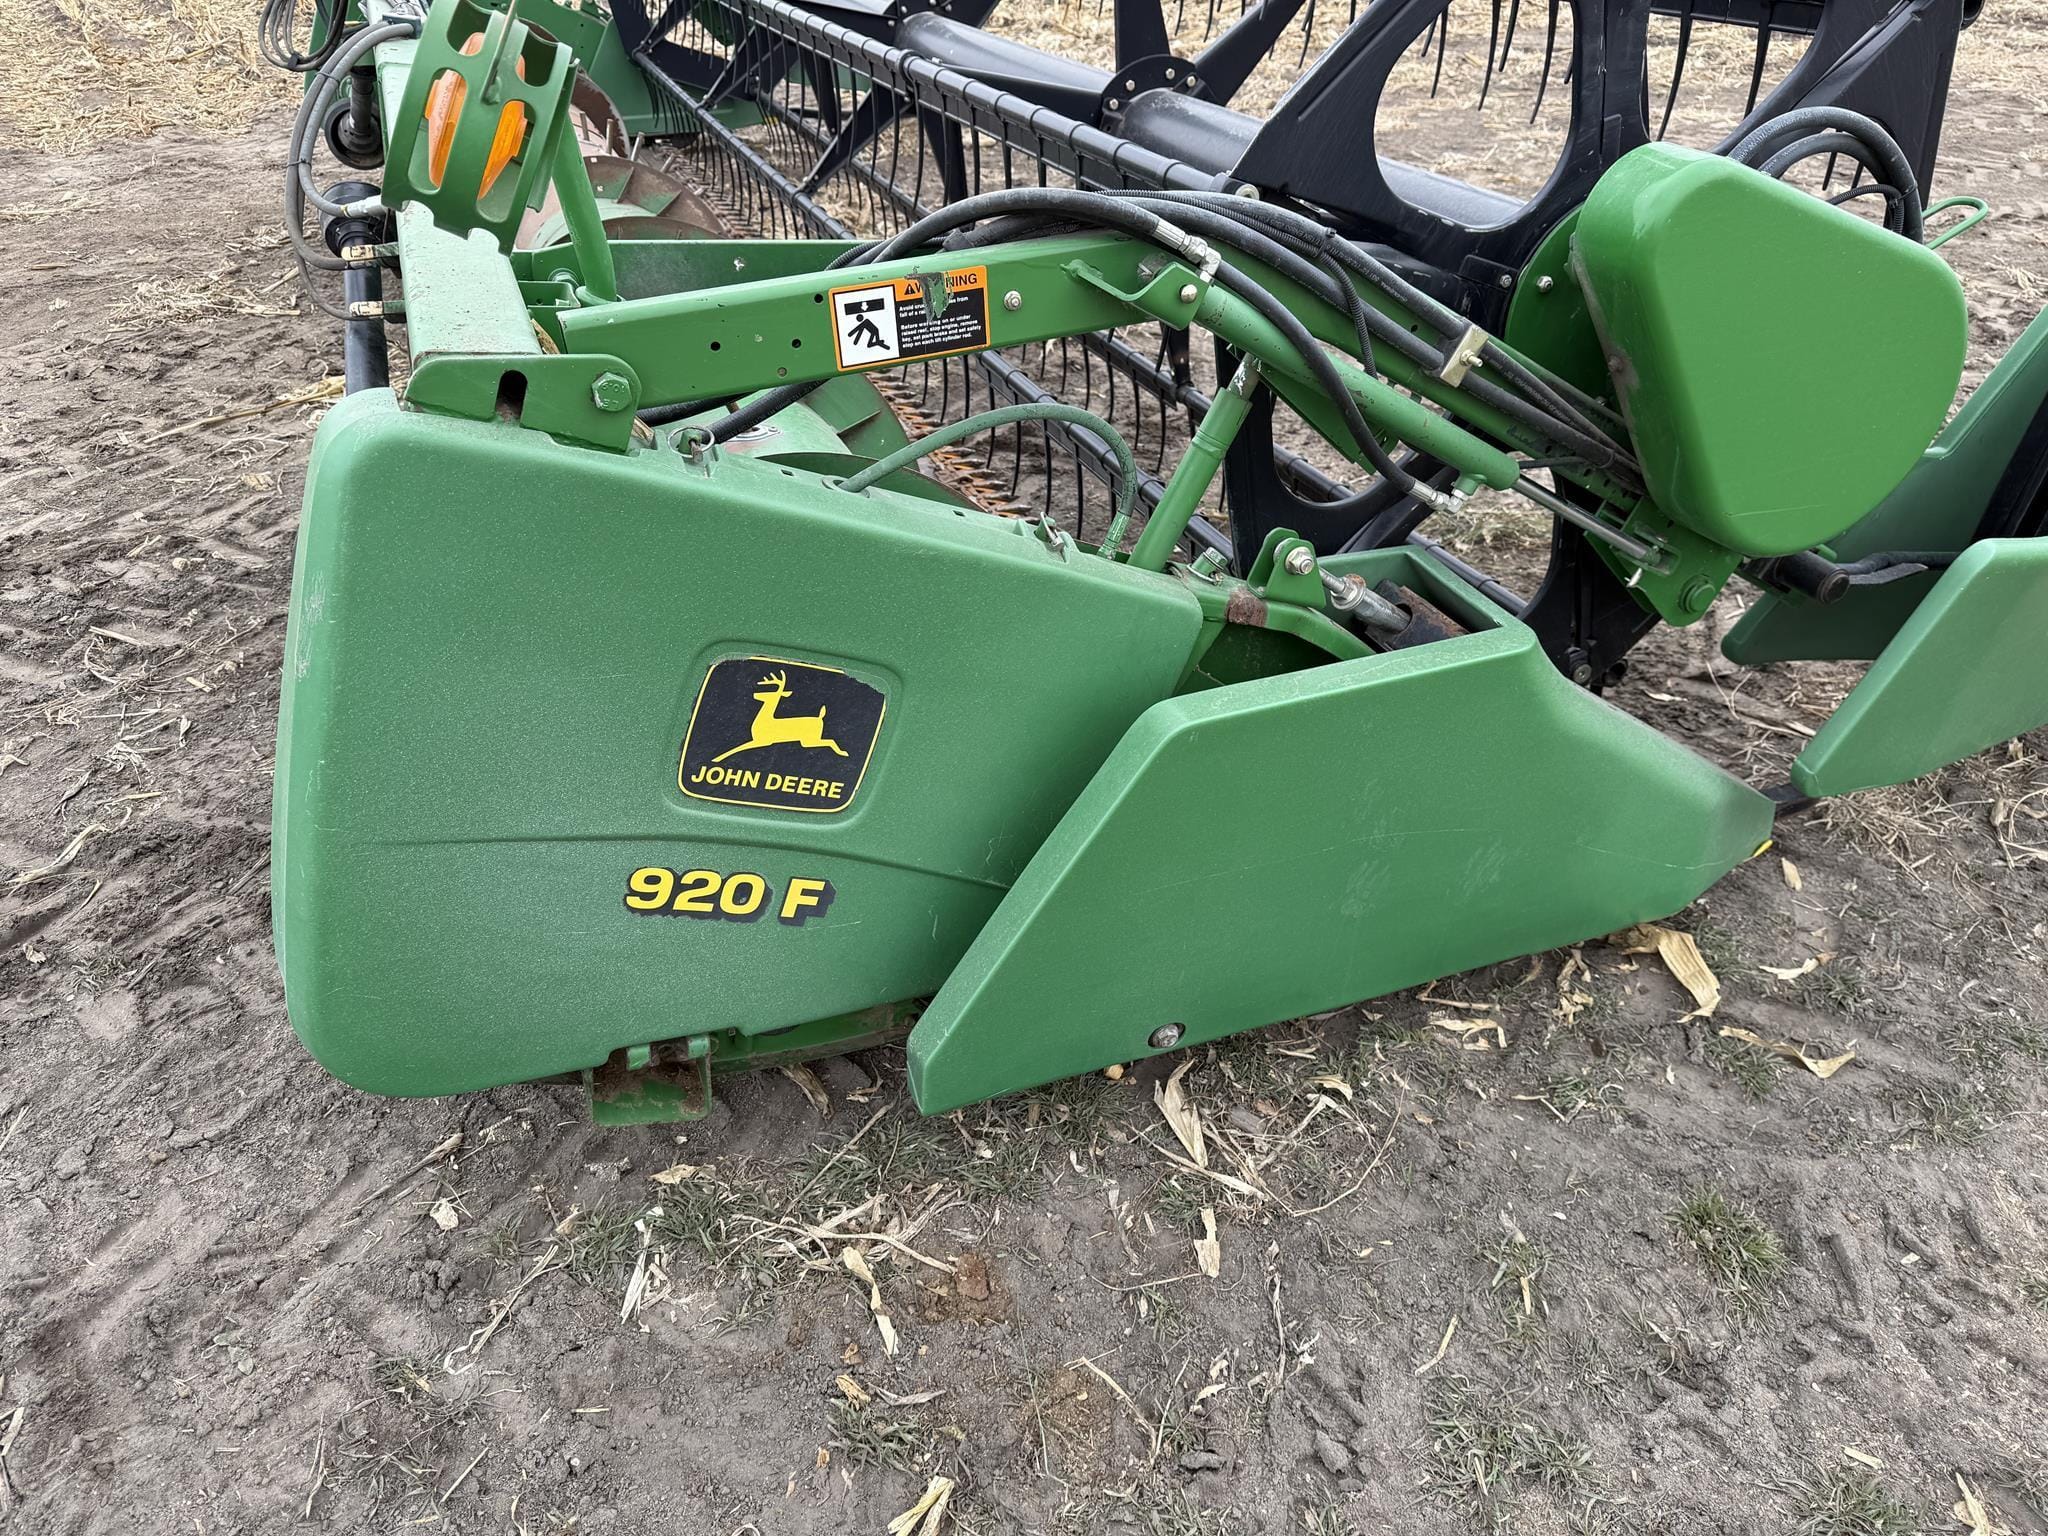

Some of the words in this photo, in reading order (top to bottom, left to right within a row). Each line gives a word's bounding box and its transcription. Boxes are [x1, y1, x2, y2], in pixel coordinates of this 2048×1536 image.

[914, 273, 977, 293] WNING
[921, 338, 935, 346] each
[691, 765, 760, 789] JOHN
[765, 774, 845, 799] DEERE
[626, 866, 766, 915] 920
[780, 878, 826, 919] F
